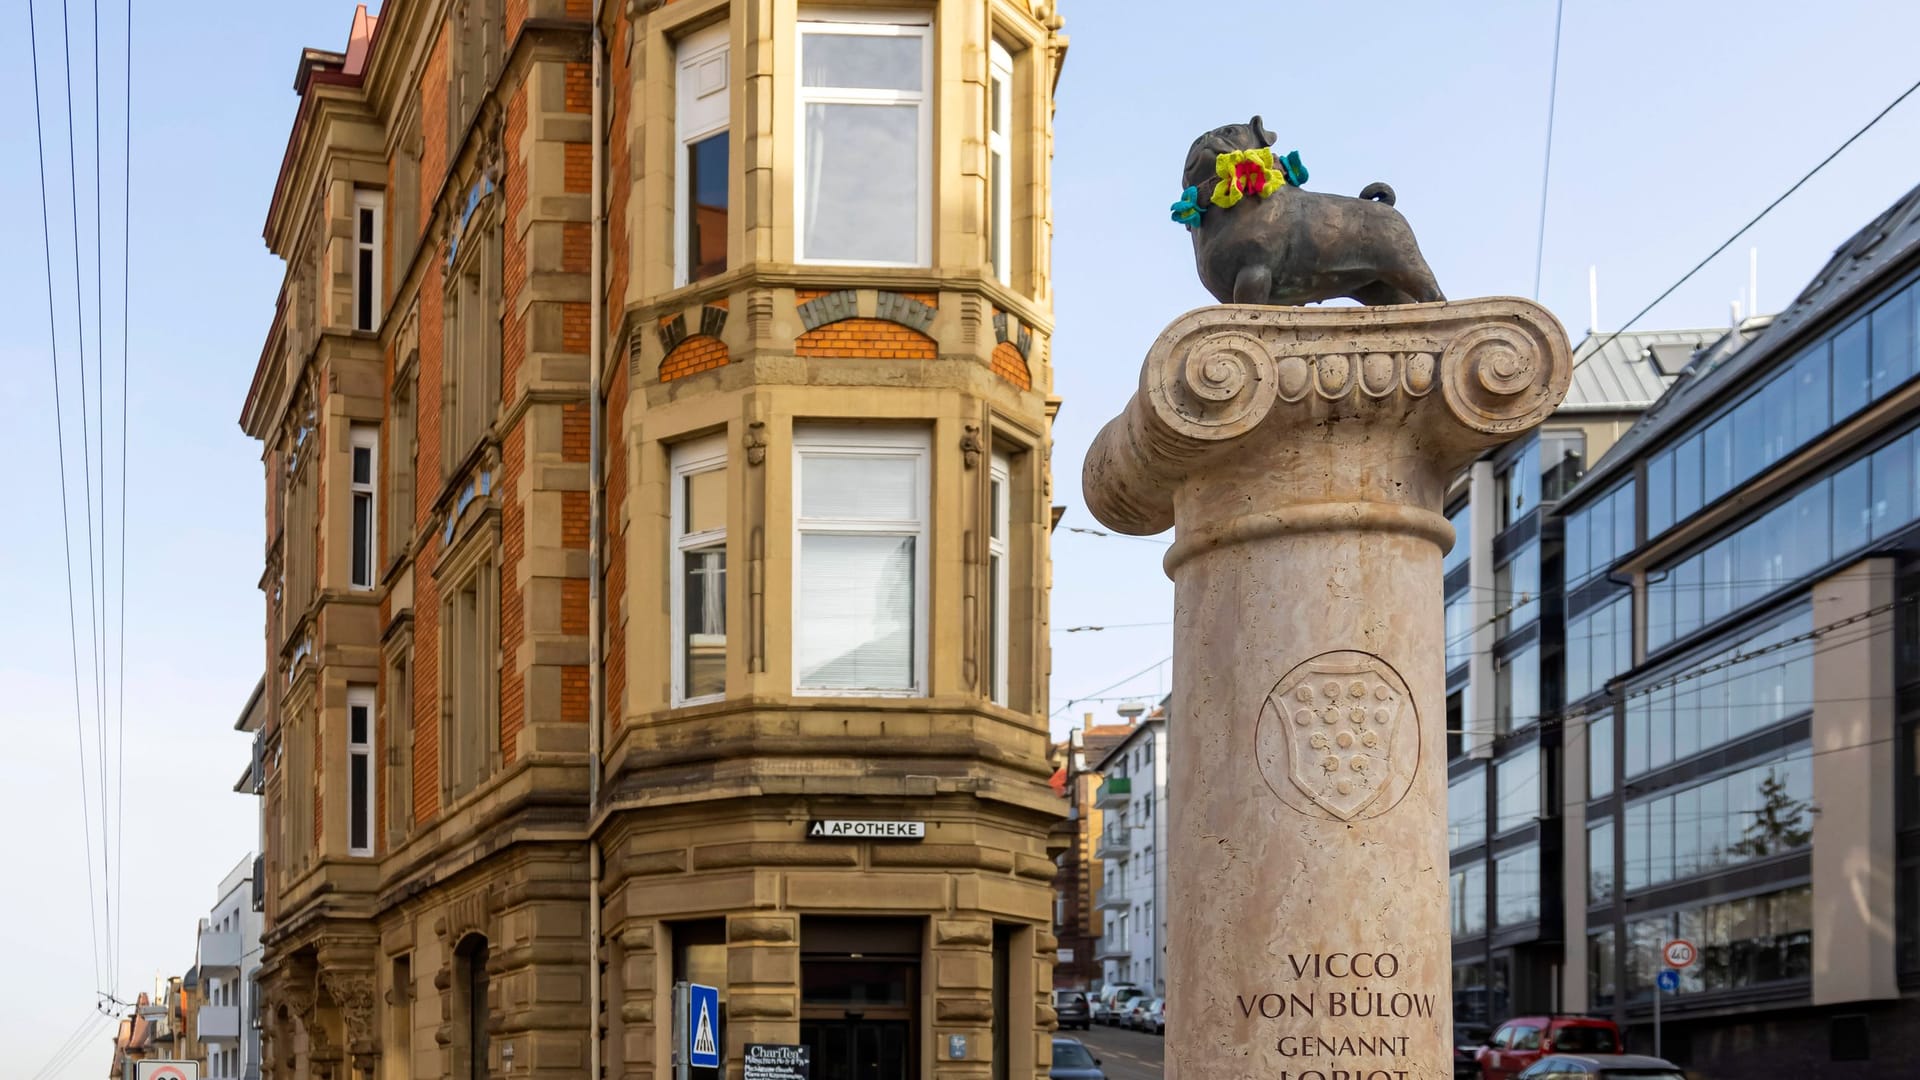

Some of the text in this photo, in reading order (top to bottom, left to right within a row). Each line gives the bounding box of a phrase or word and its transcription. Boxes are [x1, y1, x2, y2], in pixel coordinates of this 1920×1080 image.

[831, 822, 917, 835] APOTHEKE
[1671, 947, 1690, 960] 40
[1288, 953, 1399, 978] VICCO
[1236, 986, 1435, 1018] VON BÜLOW
[1277, 1036, 1410, 1057] GENANNT
